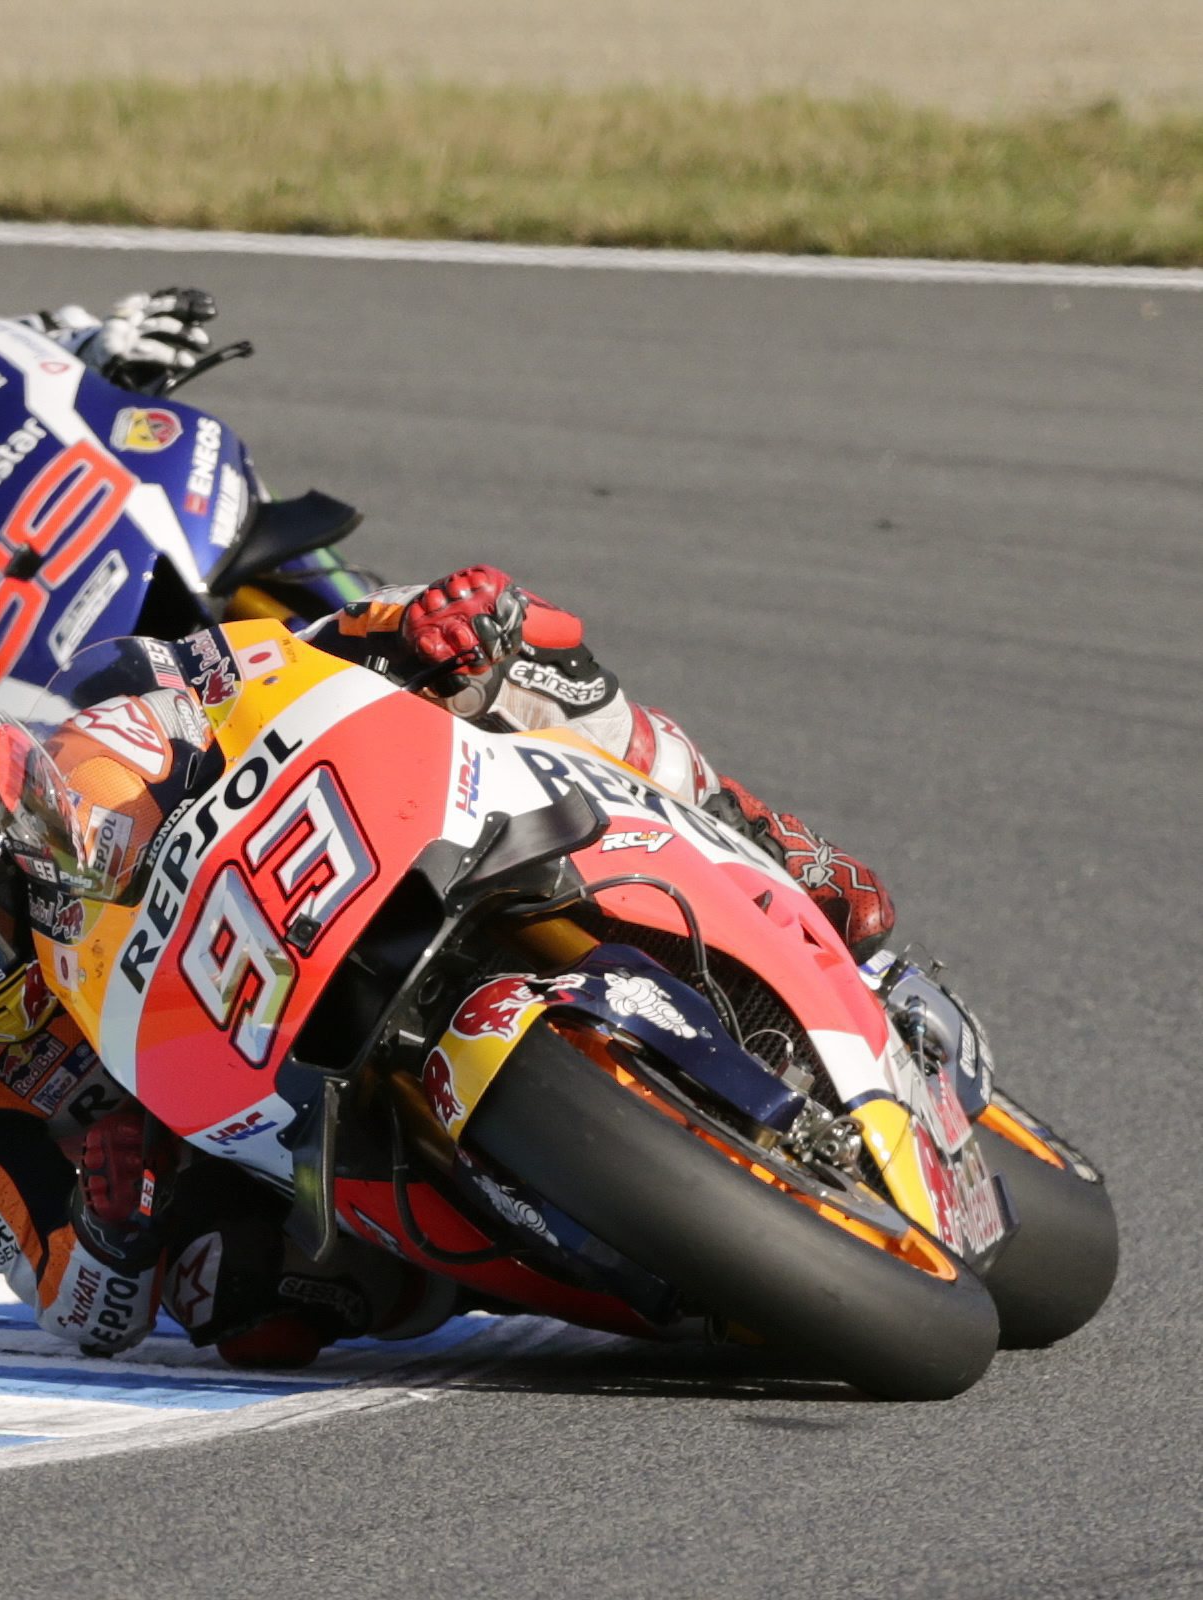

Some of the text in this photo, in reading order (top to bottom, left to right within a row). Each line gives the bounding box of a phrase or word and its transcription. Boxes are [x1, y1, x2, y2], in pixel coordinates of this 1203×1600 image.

[186, 417, 222, 497] ENEOS
[455, 741, 481, 818] HRC
[94, 817, 117, 871] EPSOL
[120, 729, 303, 994] REPSOL
[146, 798, 196, 865] HONDA
[178, 760, 380, 1069] 93
[206, 1111, 278, 1146] HRC
